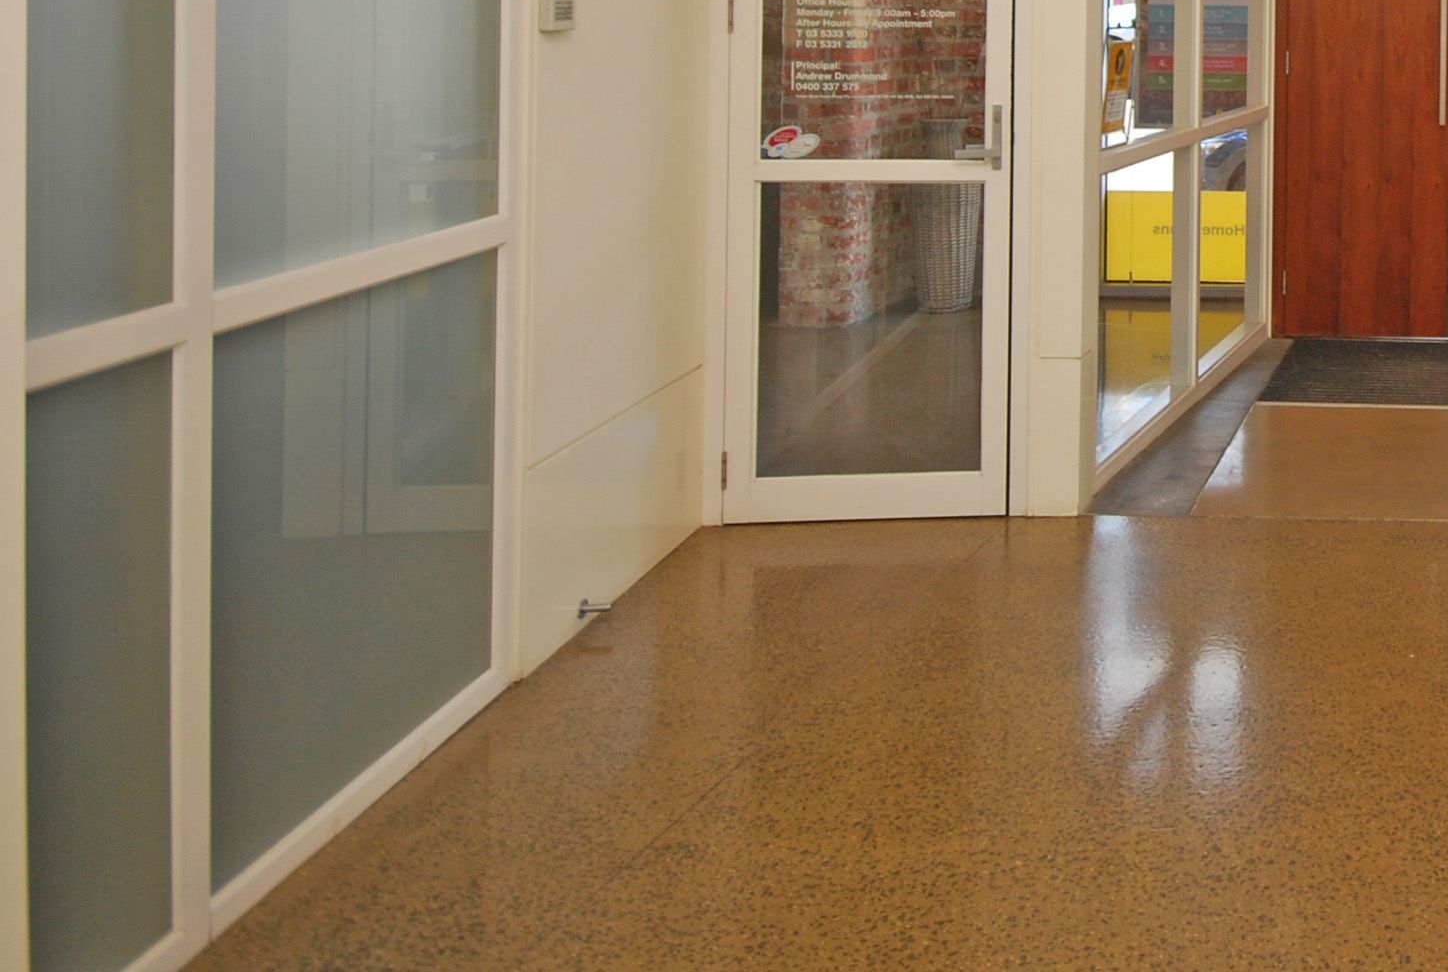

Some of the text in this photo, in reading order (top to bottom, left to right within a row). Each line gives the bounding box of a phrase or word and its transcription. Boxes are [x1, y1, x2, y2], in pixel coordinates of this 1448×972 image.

[796, 8, 834, 18] Monday
[920, 9, 956, 19] 5:00pm
[796, 19, 819, 28] After
[871, 19, 933, 30] Appointment
[796, 29, 803, 38] T
[805, 29, 818, 38] 03
[820, 29, 844, 38] 5333
[796, 40, 802, 49] F
[805, 40, 818, 49] 03
[820, 40, 841, 49] 5331
[796, 61, 841, 72] Principal:
[795, 72, 888, 81] Andrew Drummond
[795, 82, 819, 91] 0400
[822, 82, 840, 91] 337
